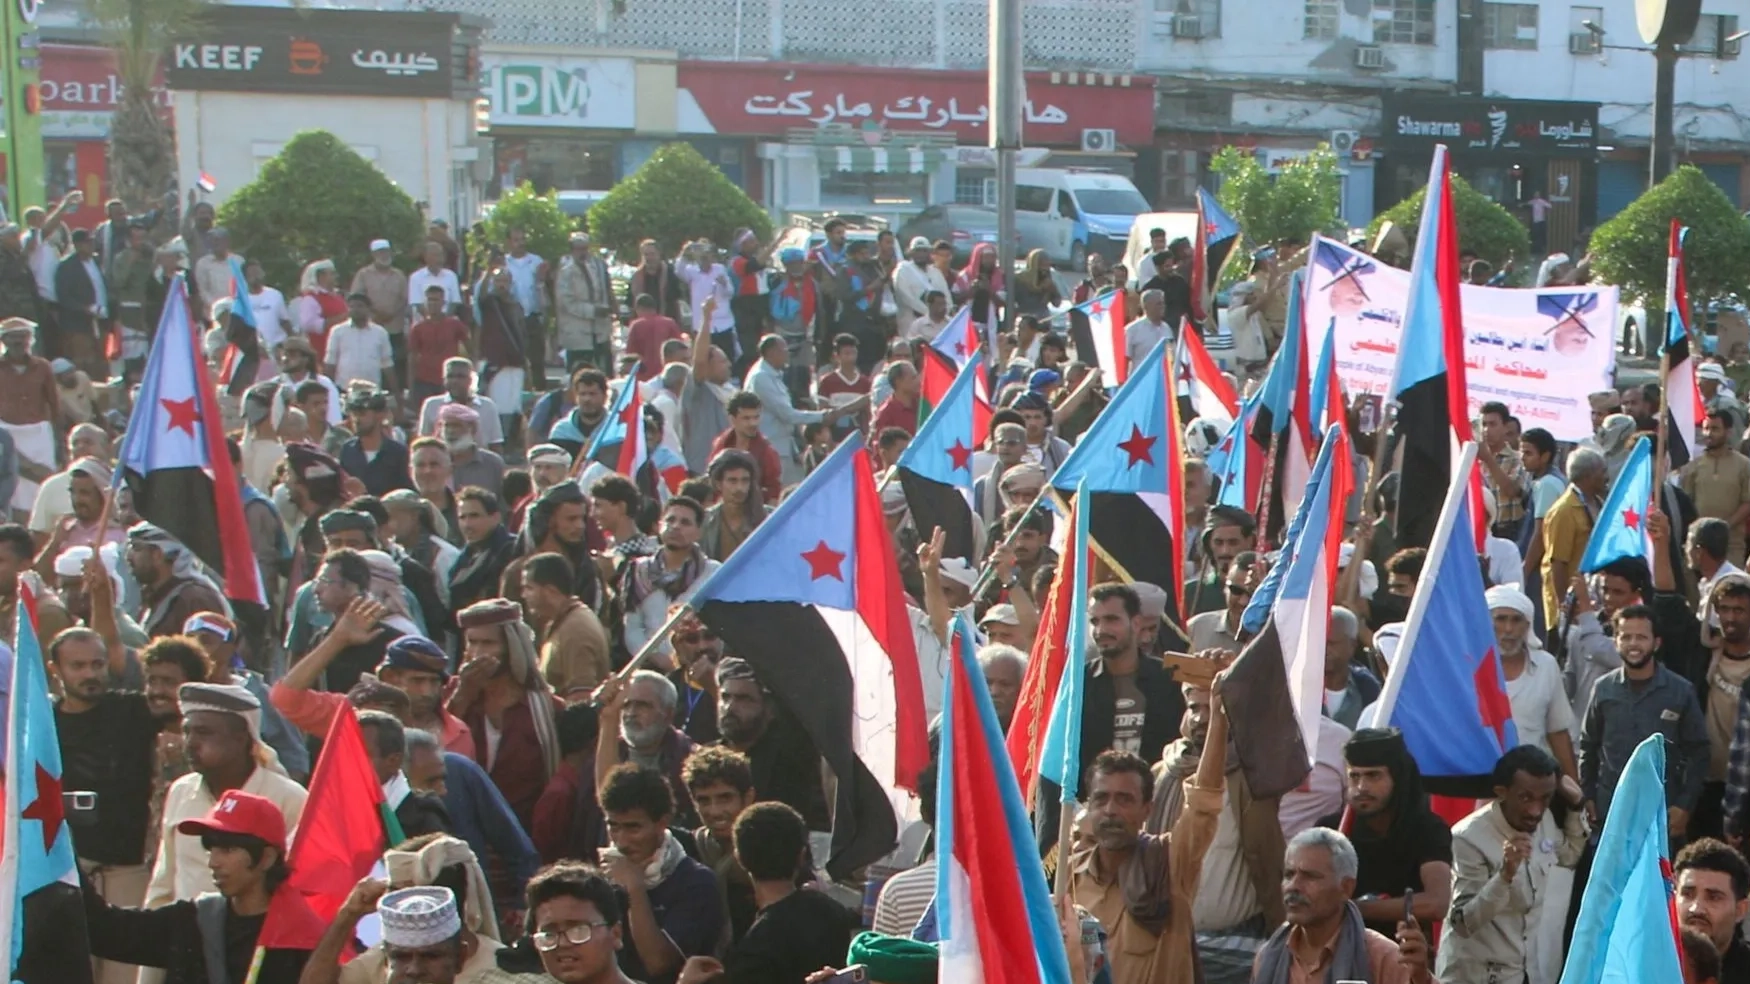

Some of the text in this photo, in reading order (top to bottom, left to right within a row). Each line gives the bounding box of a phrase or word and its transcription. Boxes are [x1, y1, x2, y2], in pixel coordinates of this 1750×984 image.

[175, 44, 263, 70] KEEF
[351, 49, 439, 75] كييف
[744, 90, 872, 125] ماركت
[1397, 115, 1461, 137] Shawarma
[1539, 118, 1593, 140] شاورما
